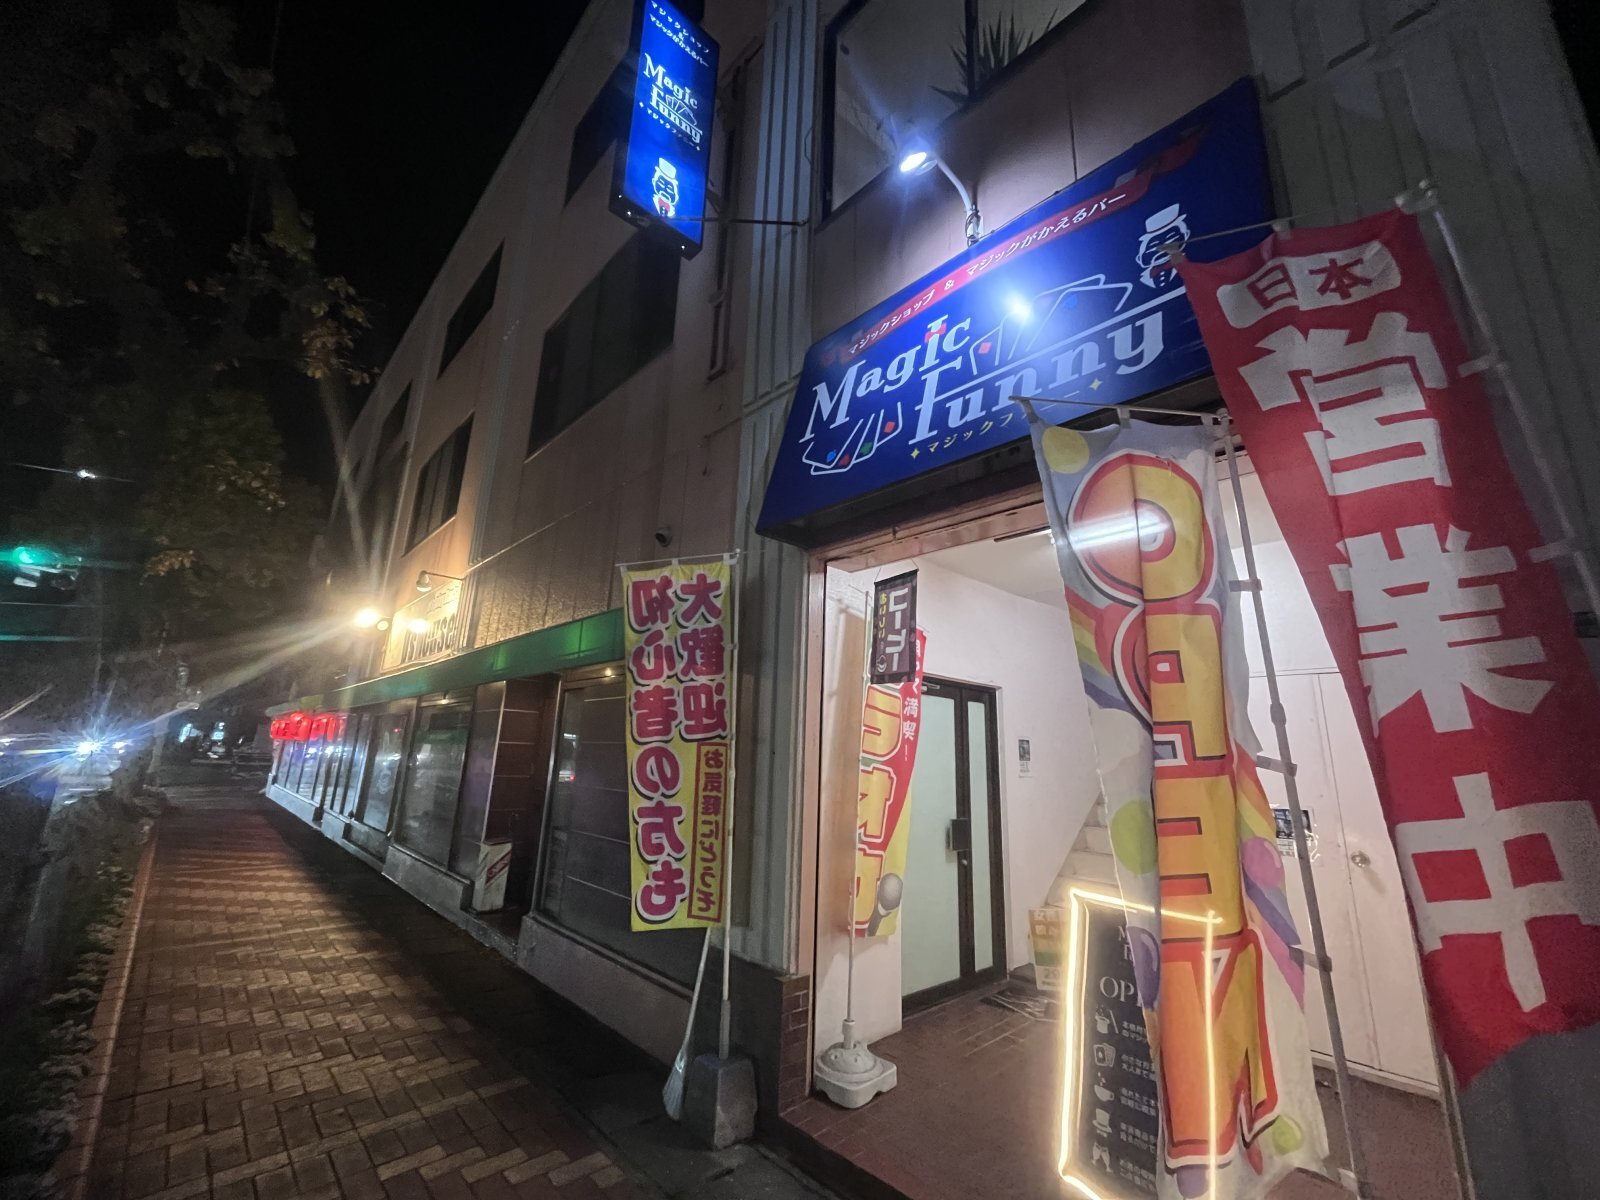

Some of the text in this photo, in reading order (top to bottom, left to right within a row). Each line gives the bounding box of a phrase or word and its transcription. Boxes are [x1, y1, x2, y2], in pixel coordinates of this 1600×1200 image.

[643, 53, 698, 108] Magic
[650, 84, 703, 143] Funny
[848, 193, 1127, 354] マジックショップ & マジックがかえるバー
[1246, 257, 1373, 310] 日本
[799, 314, 972, 444] Magic
[908, 310, 1165, 446] Funny
[1238, 312, 1600, 1014] 営業中
